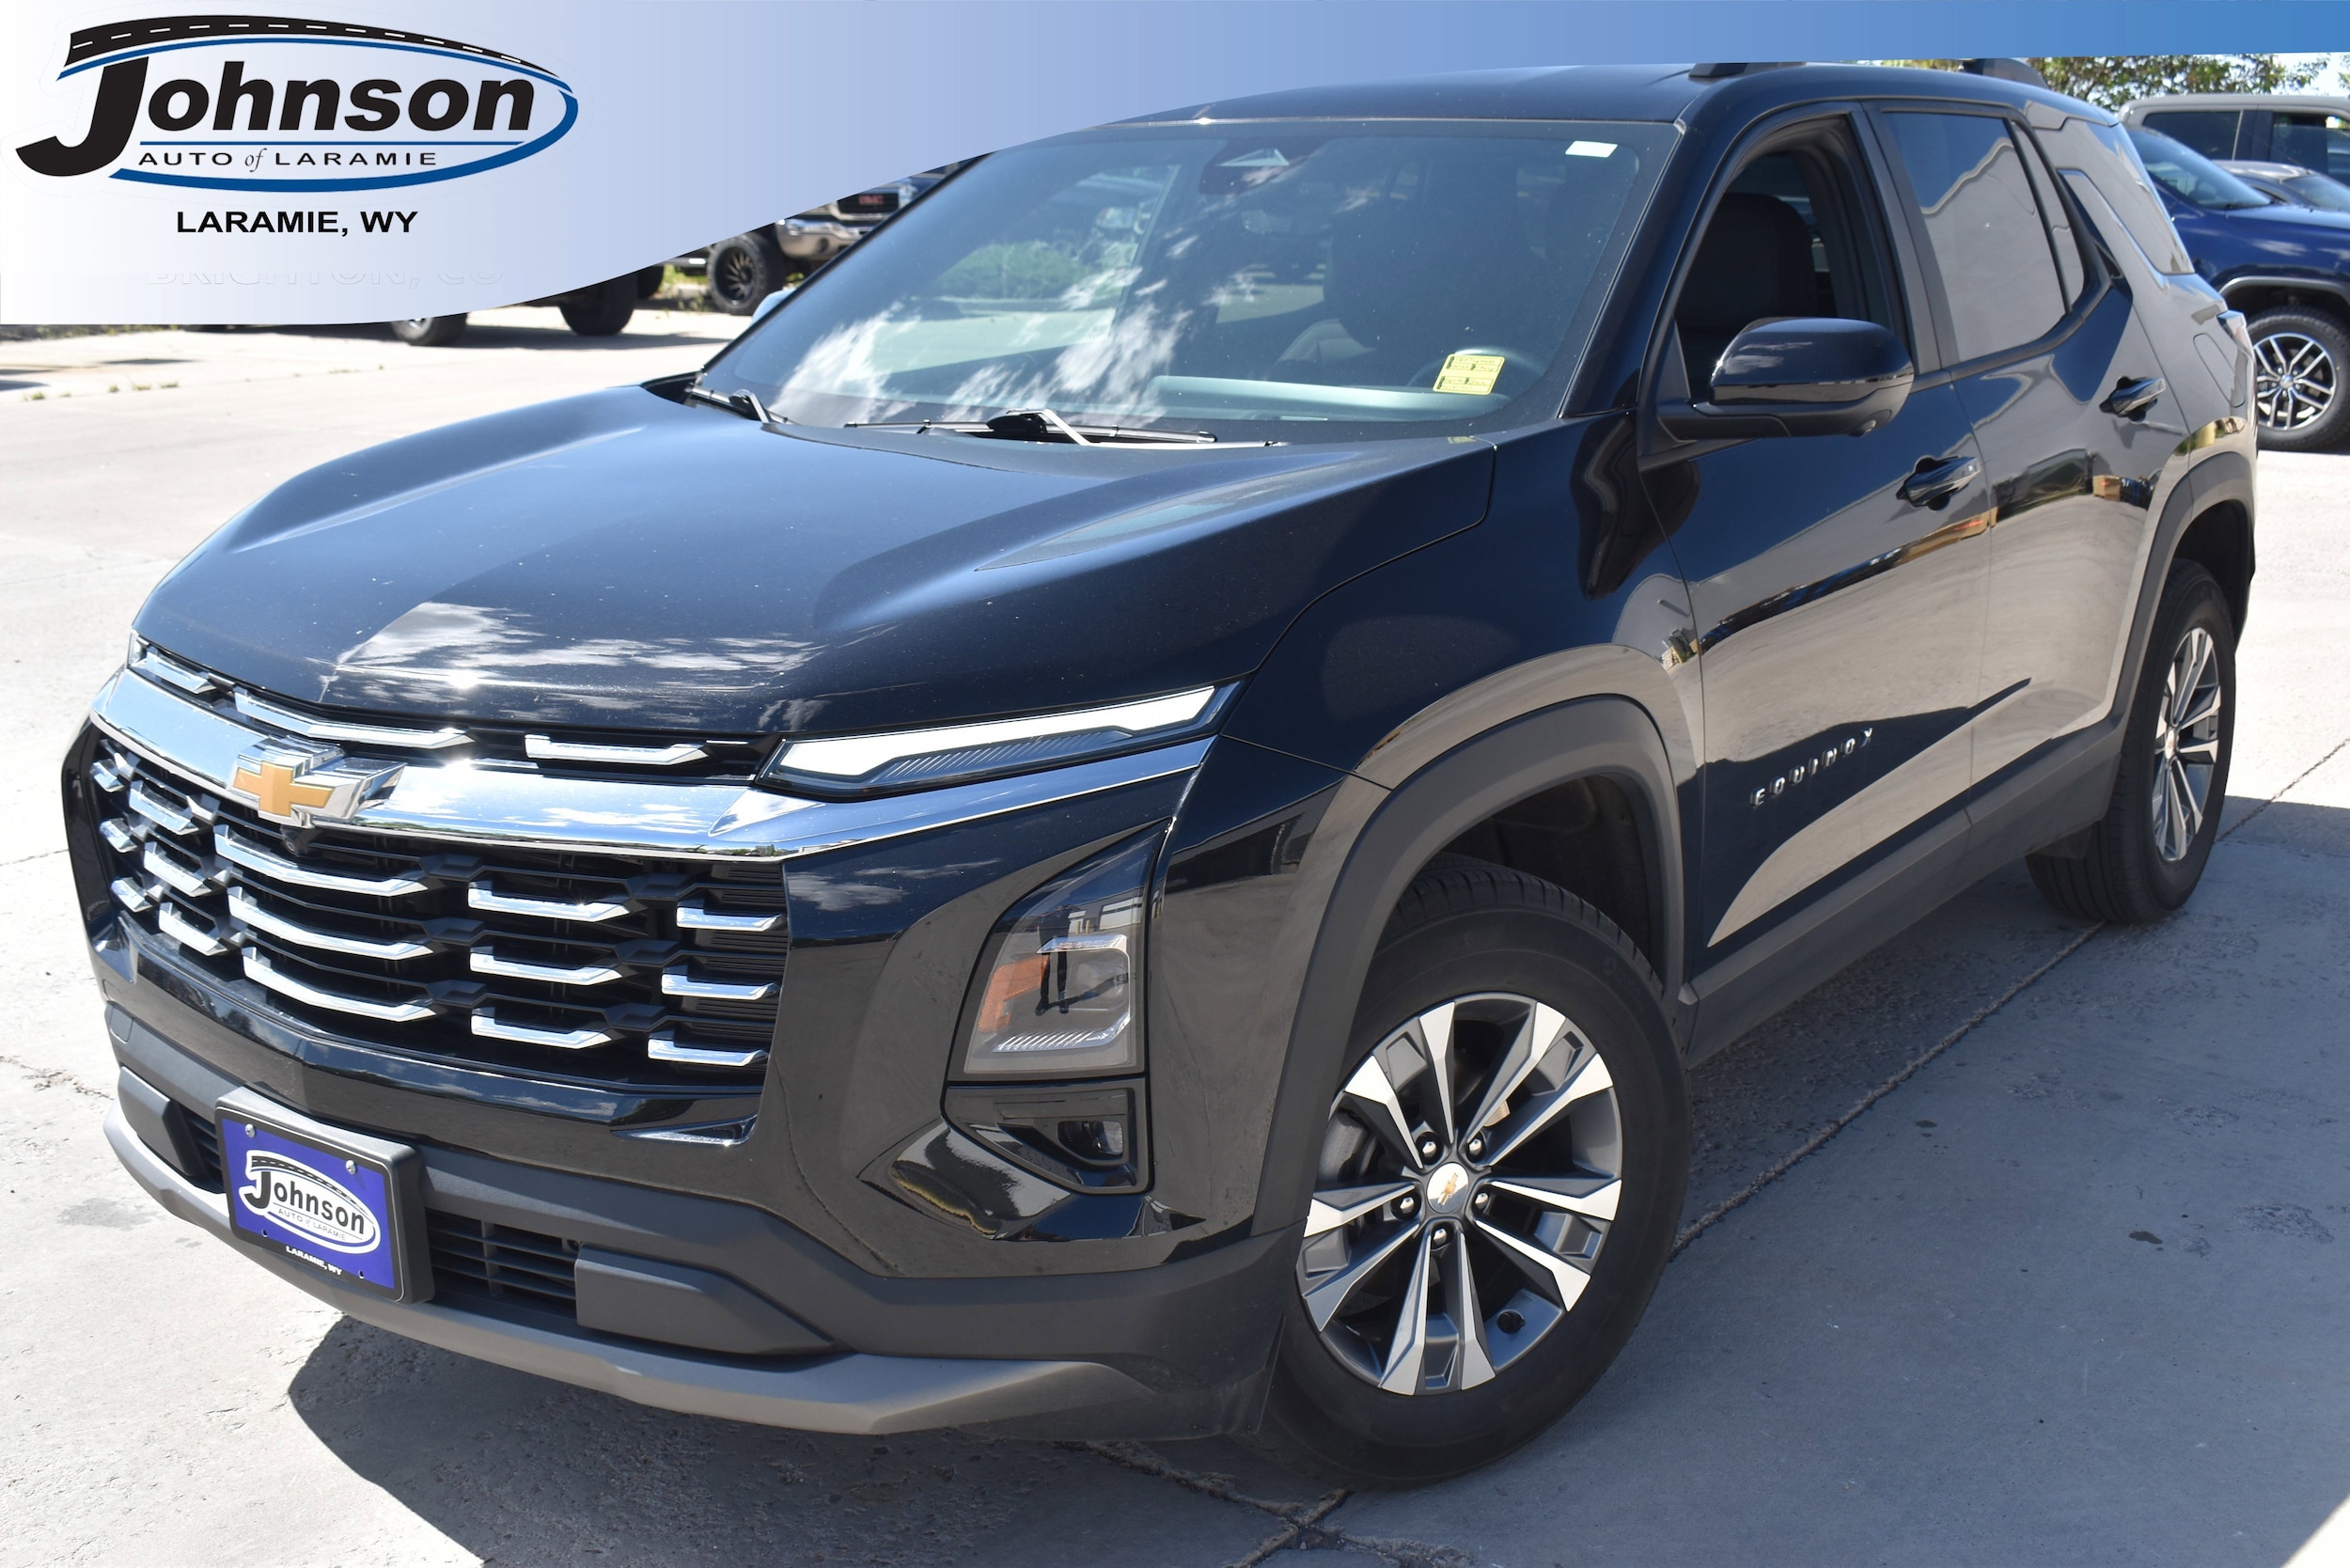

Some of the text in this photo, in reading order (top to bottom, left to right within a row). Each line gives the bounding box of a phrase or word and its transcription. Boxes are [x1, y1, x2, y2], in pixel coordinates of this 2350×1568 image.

[1749, 727, 1873, 808] EQUINOX
[243, 1170, 365, 1235] Johnson
[278, 1208, 304, 1223] AUTO
[313, 1221, 347, 1241] LARAMIE
[286, 1245, 343, 1276] LARAMIE, WY
